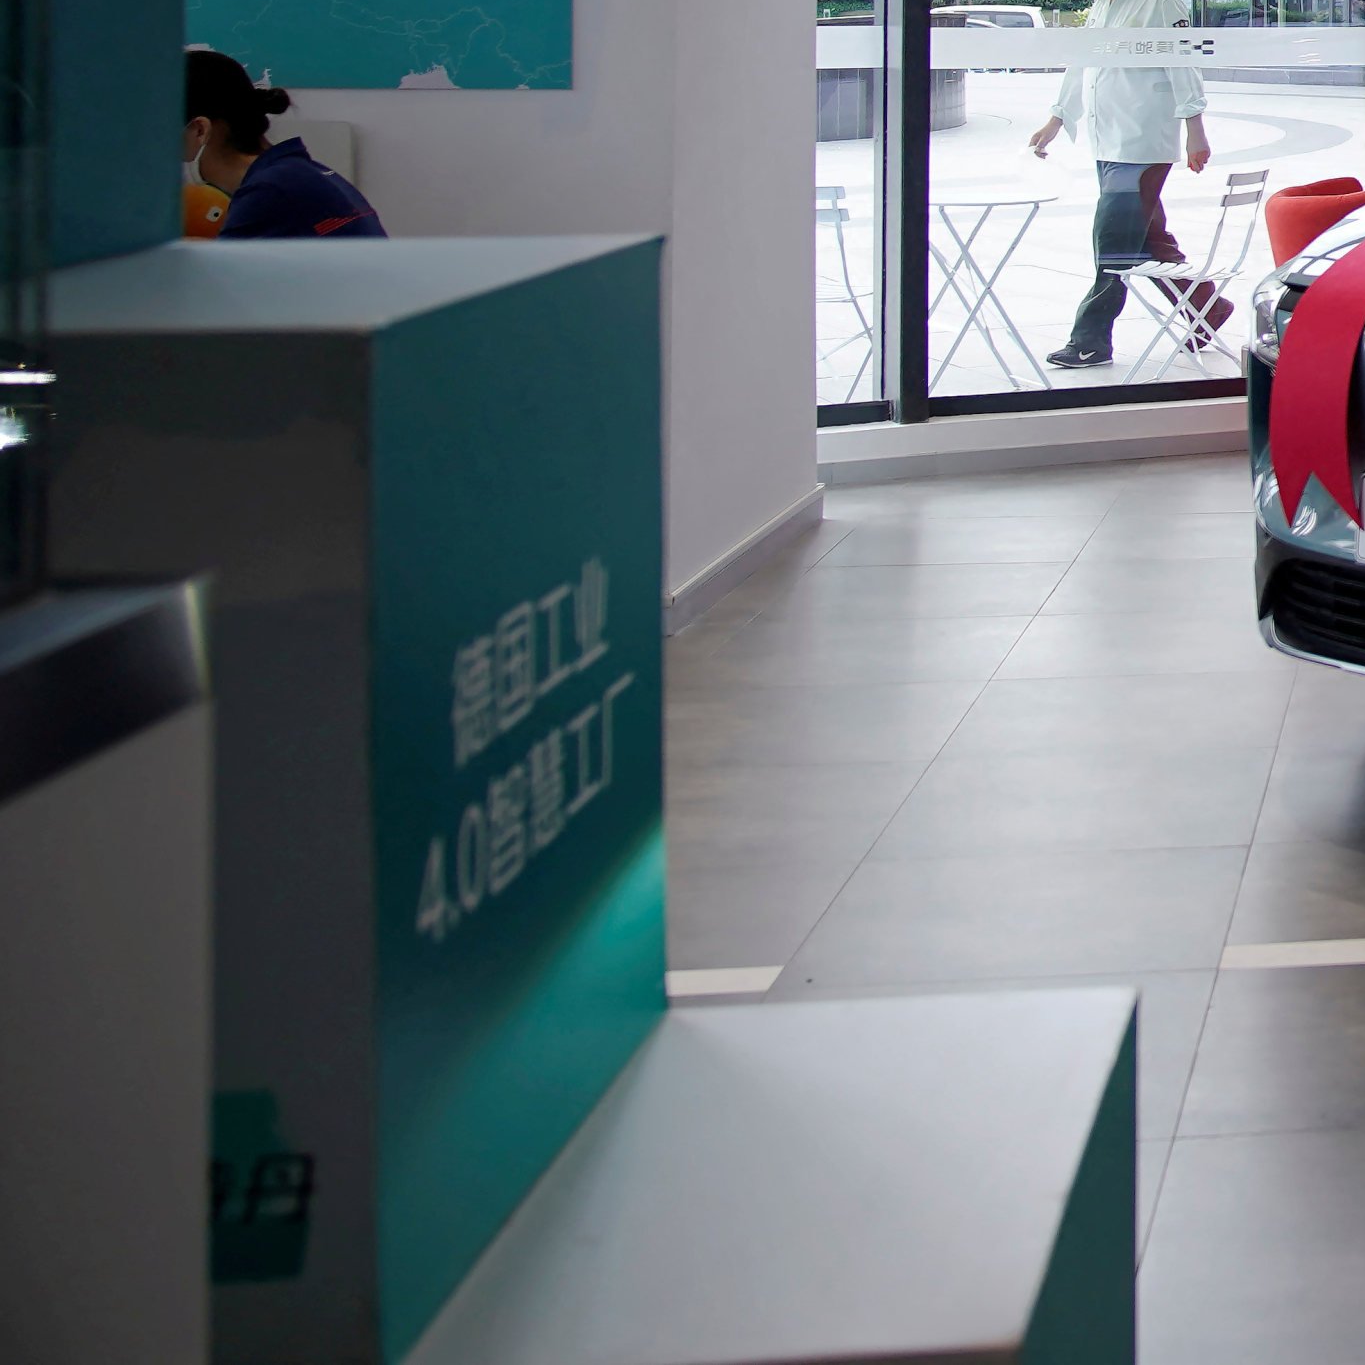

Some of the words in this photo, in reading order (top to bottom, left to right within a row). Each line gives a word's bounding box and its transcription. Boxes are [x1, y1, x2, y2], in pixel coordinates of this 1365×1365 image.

[451, 556, 610, 771] 德国工业
[414, 671, 638, 944] 4.0智慧工厂
